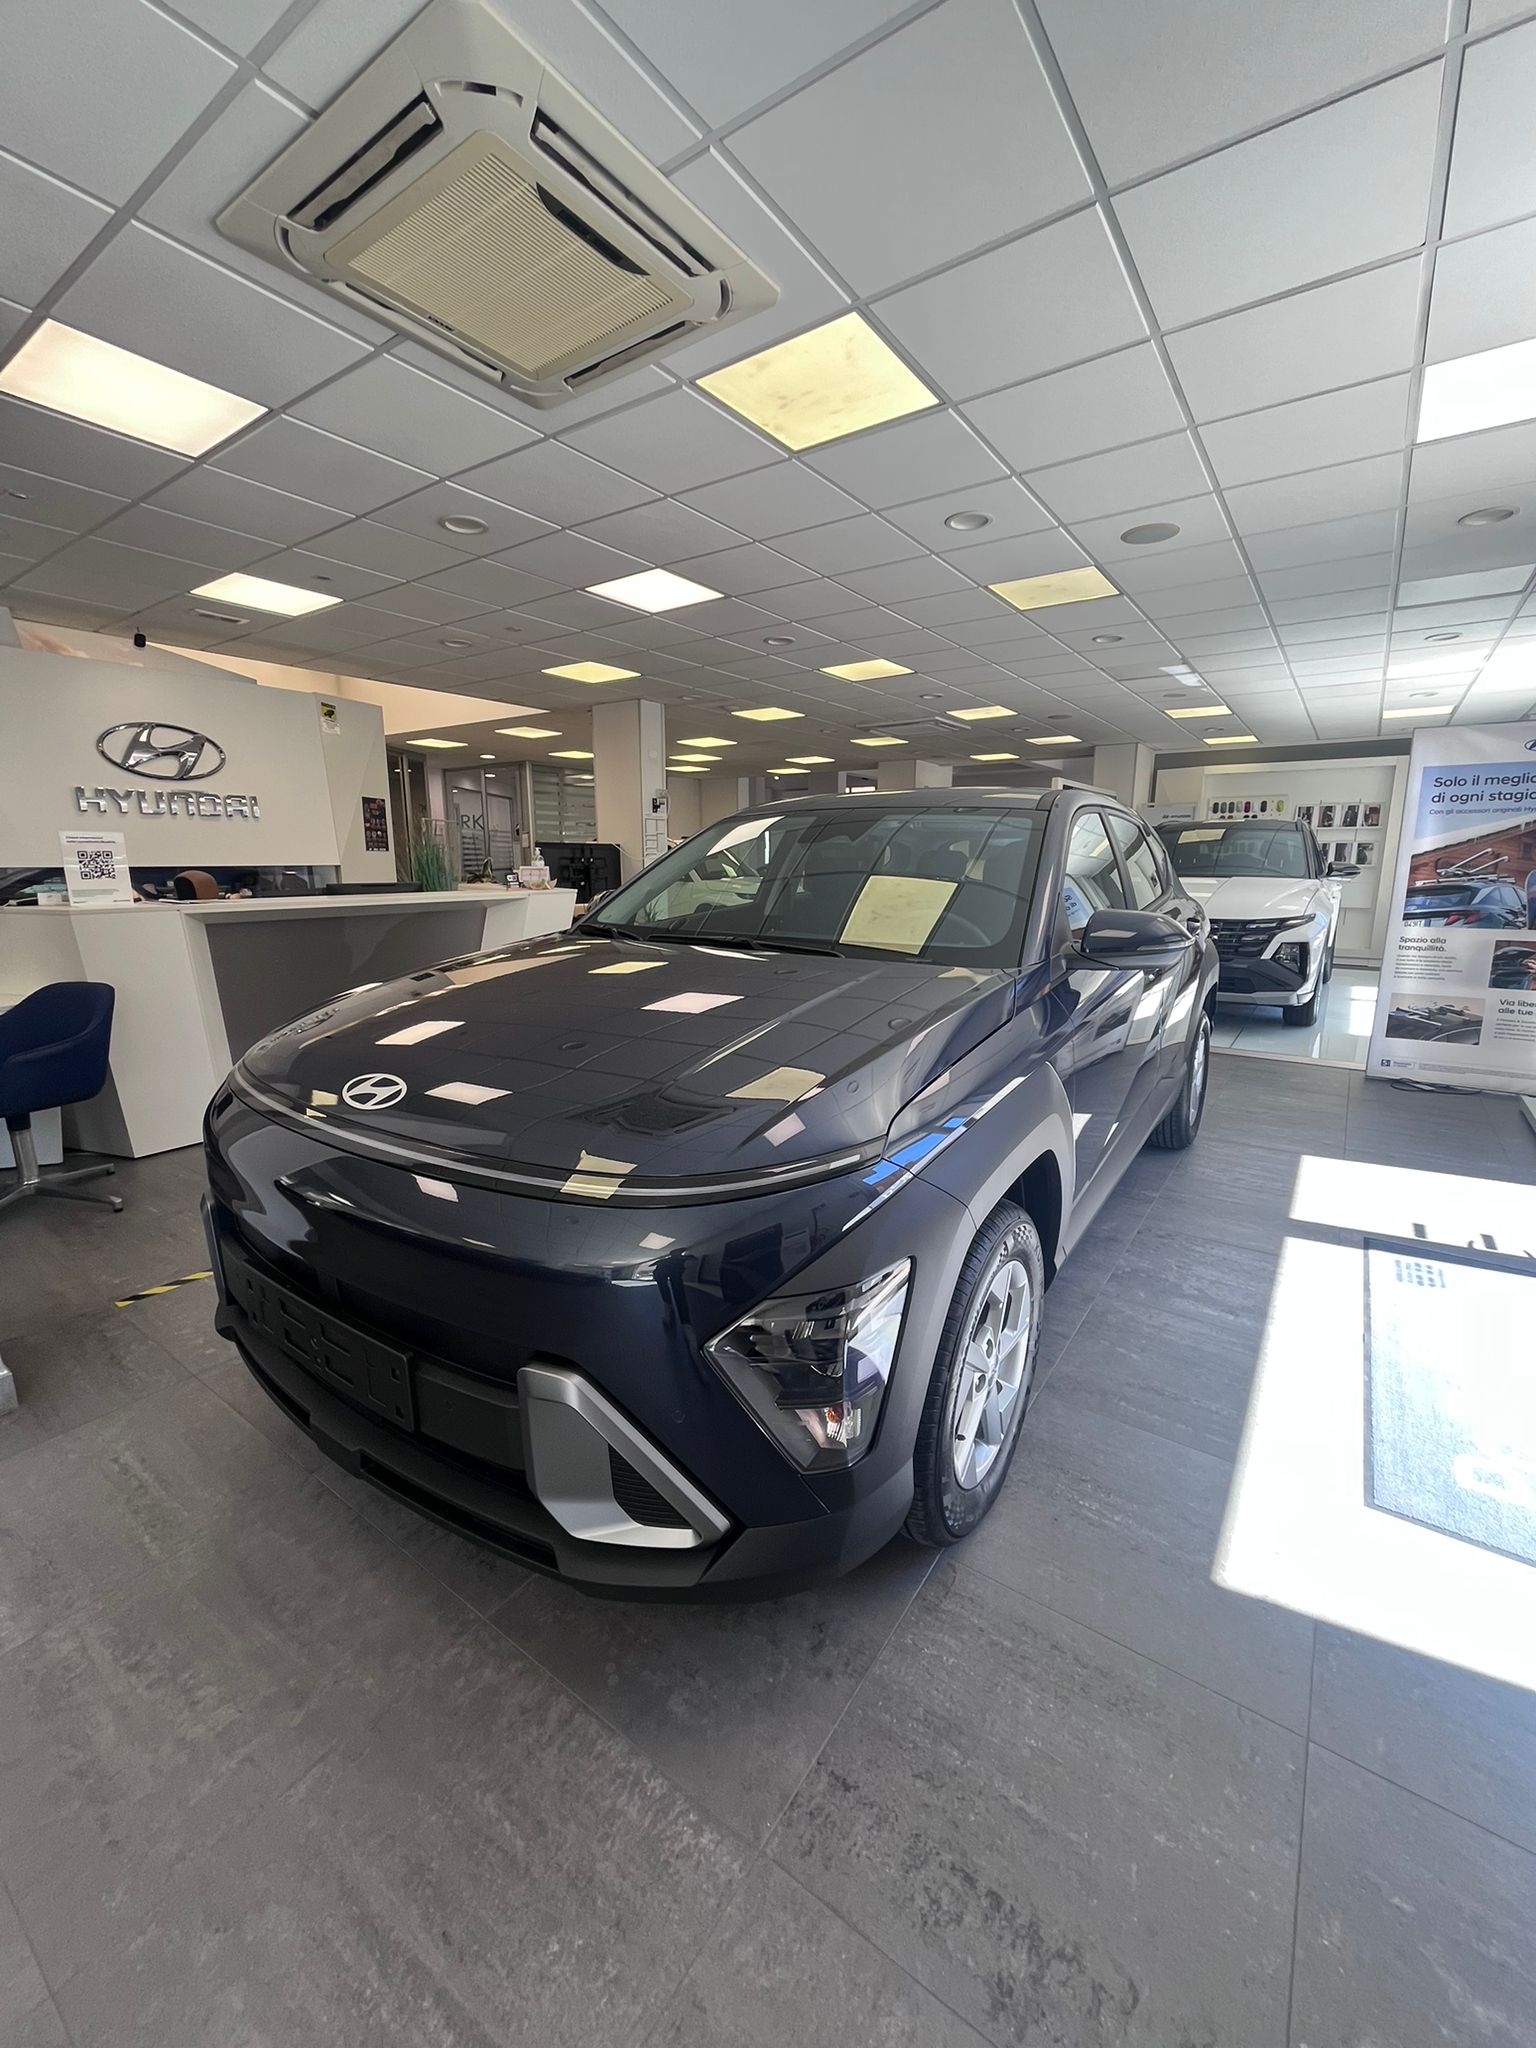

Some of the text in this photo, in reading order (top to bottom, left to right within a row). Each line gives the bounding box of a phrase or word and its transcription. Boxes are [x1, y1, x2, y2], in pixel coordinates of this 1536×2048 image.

[1433, 776, 1468, 788] Solo
[1472, 774, 1481, 786] il
[75, 786, 260, 818] HYUNDAI
[1431, 791, 1446, 803] di
[1449, 790, 1485, 805] ogni
[1399, 936, 1447, 944] Spazio alla
[1499, 998, 1515, 1006] Via
[1517, 1008, 1533, 1016] tue
